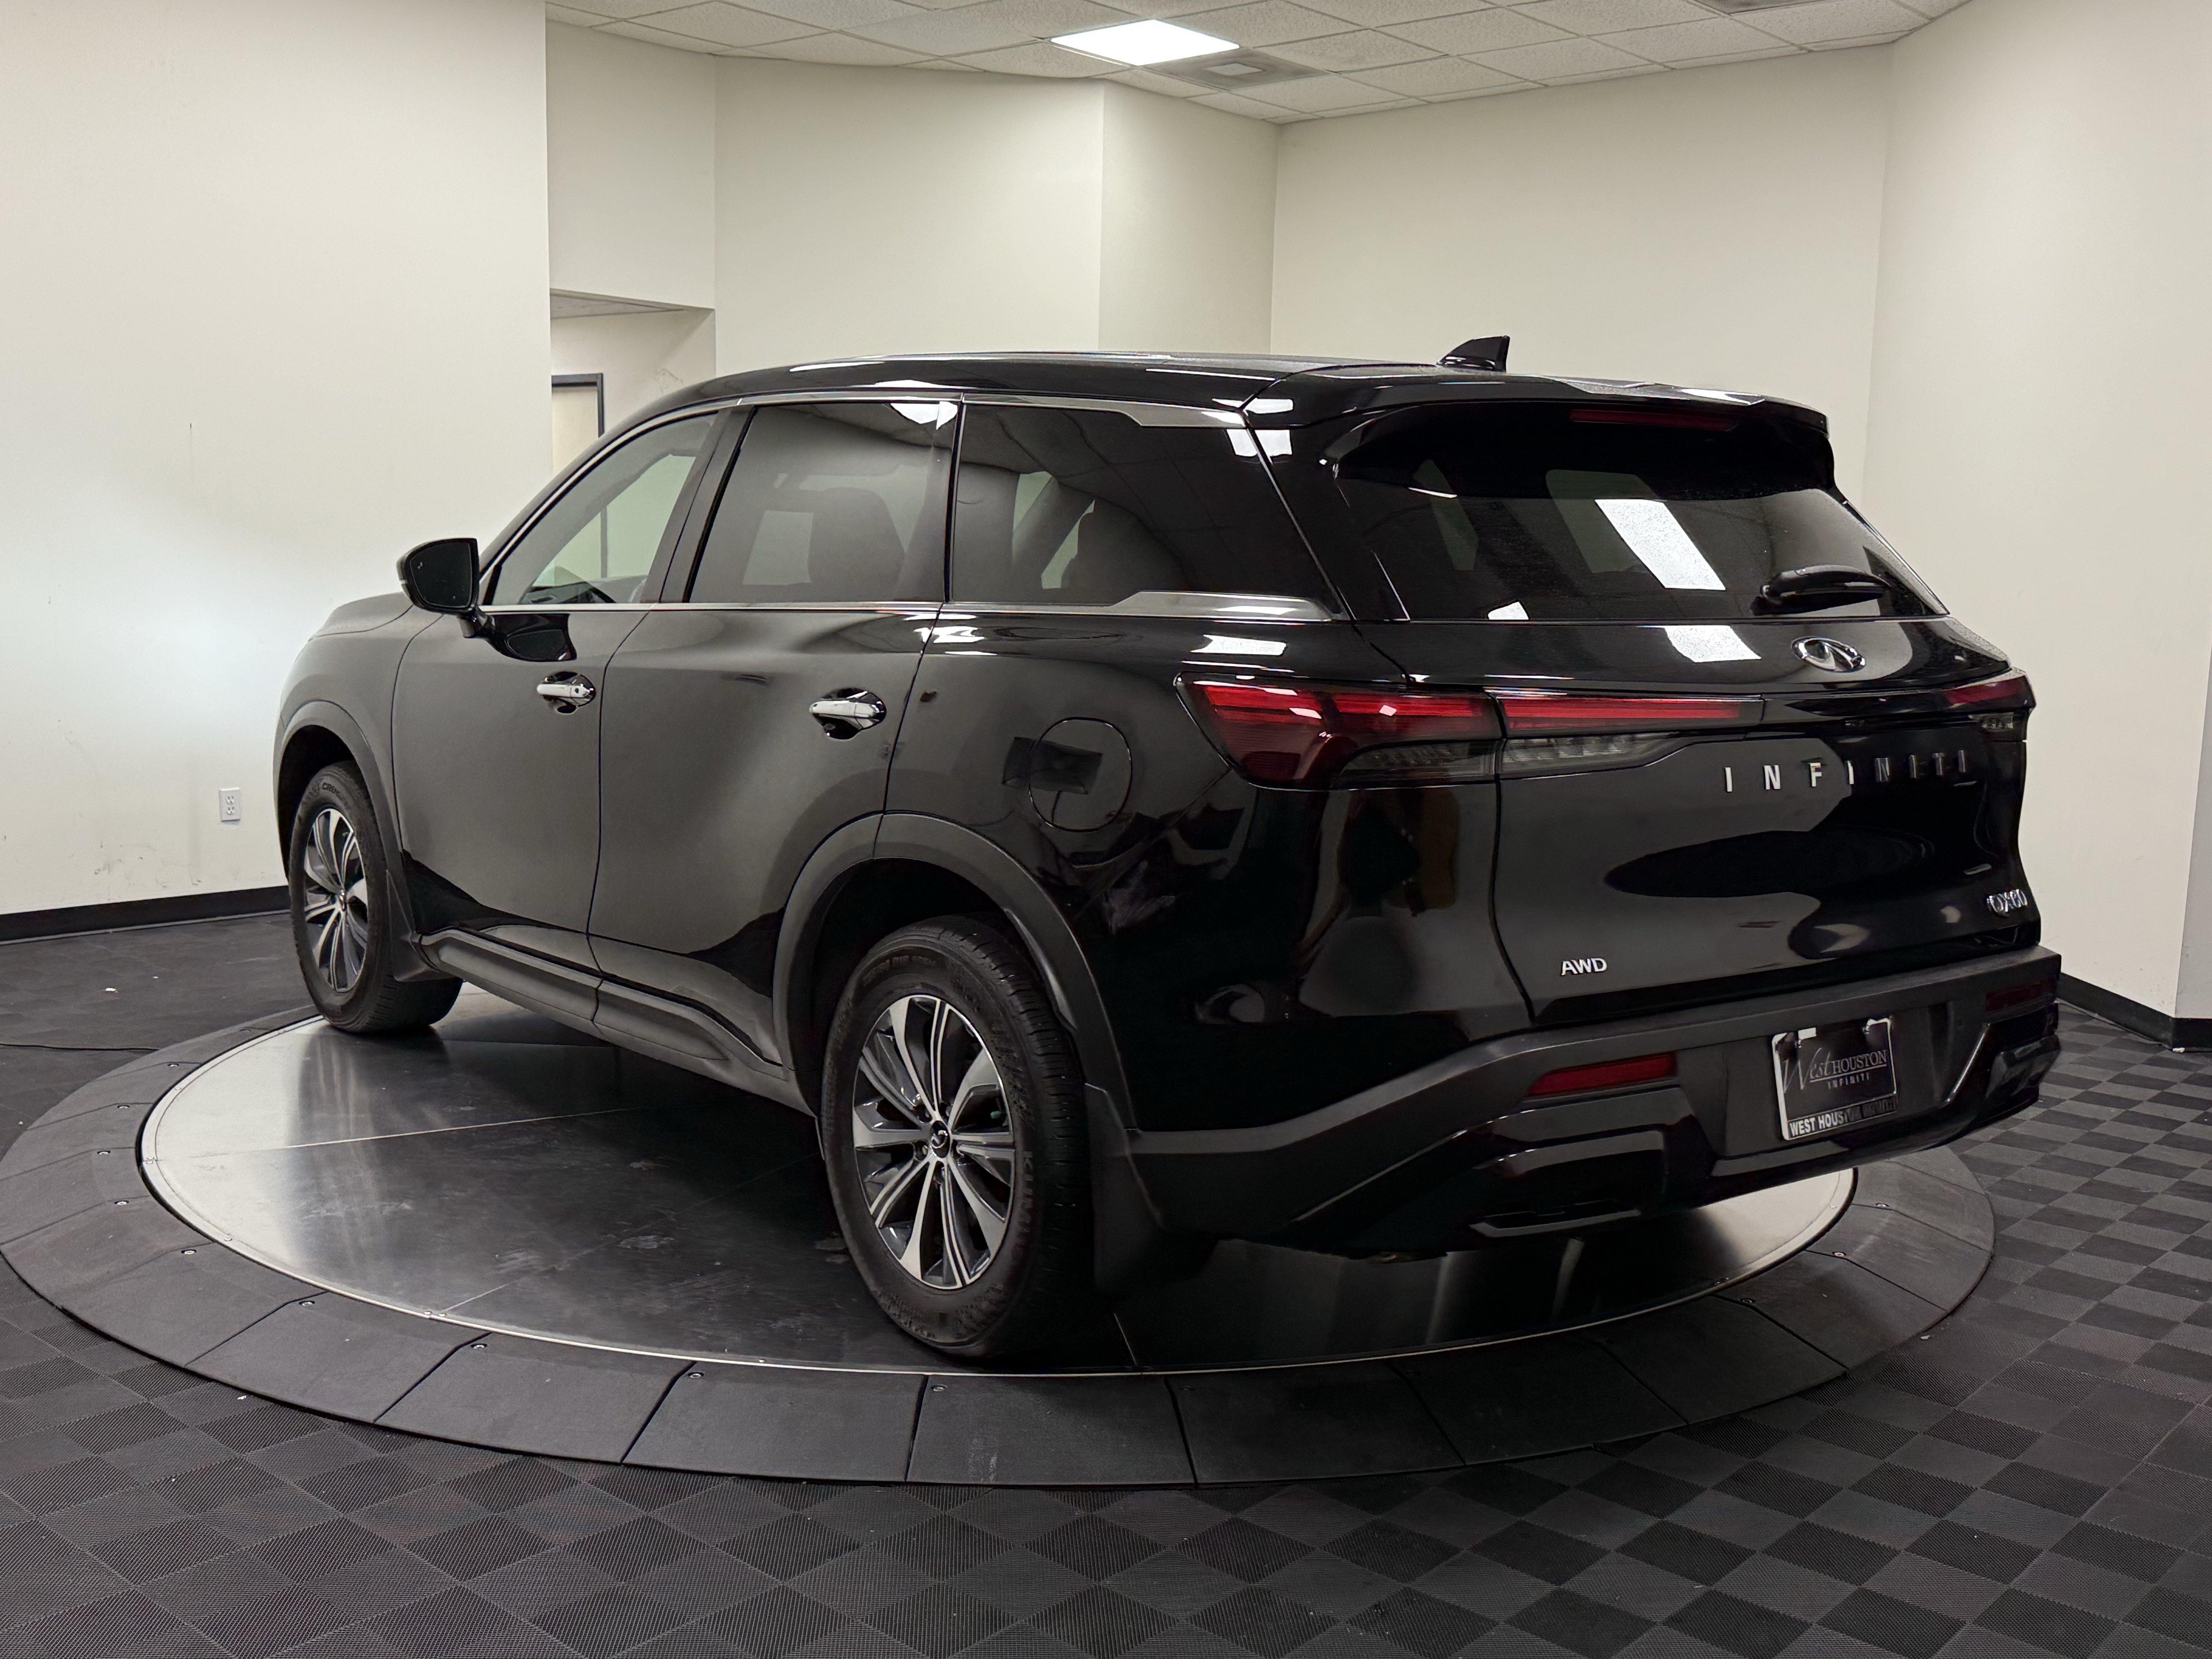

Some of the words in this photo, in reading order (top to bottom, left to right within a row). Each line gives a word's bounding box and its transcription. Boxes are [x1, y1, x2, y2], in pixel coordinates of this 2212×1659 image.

[1724, 750, 1966, 792] INFINITI
[1561, 958, 1607, 976] AWD
[1783, 1048, 1832, 1094] West
[1832, 1050, 1887, 1074] HOUSTON
[1828, 1072, 1870, 1089] INFINITI
[1790, 1118, 1816, 1137] WEST
